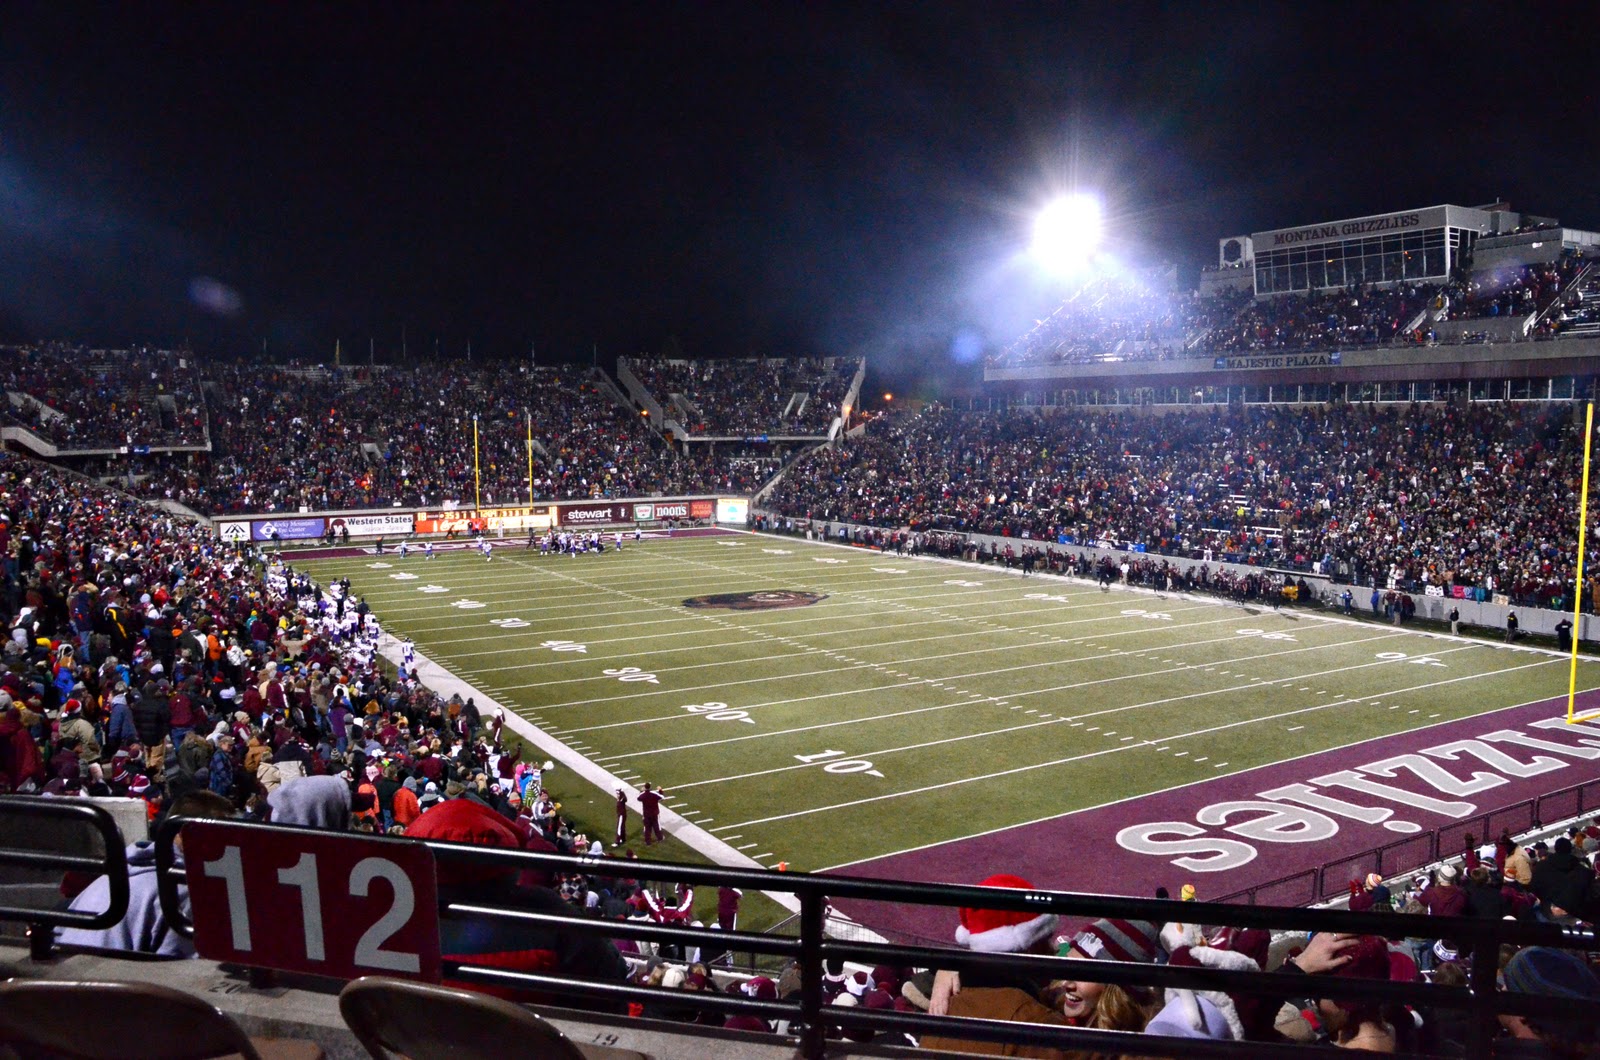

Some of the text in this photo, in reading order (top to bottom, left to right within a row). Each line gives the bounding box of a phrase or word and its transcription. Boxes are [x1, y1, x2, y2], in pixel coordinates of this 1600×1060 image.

[1274, 214, 1419, 245] MONTANA GRIZZLIES
[1227, 357, 1283, 369] MAJESTIC
[1286, 355, 1327, 367] PLAZA
[347, 515, 412, 526] Western States
[568, 508, 612, 519] stewart
[602, 667, 656, 682] 30
[681, 701, 749, 721] 20
[793, 749, 873, 774] 10
[204, 845, 421, 973] 112
